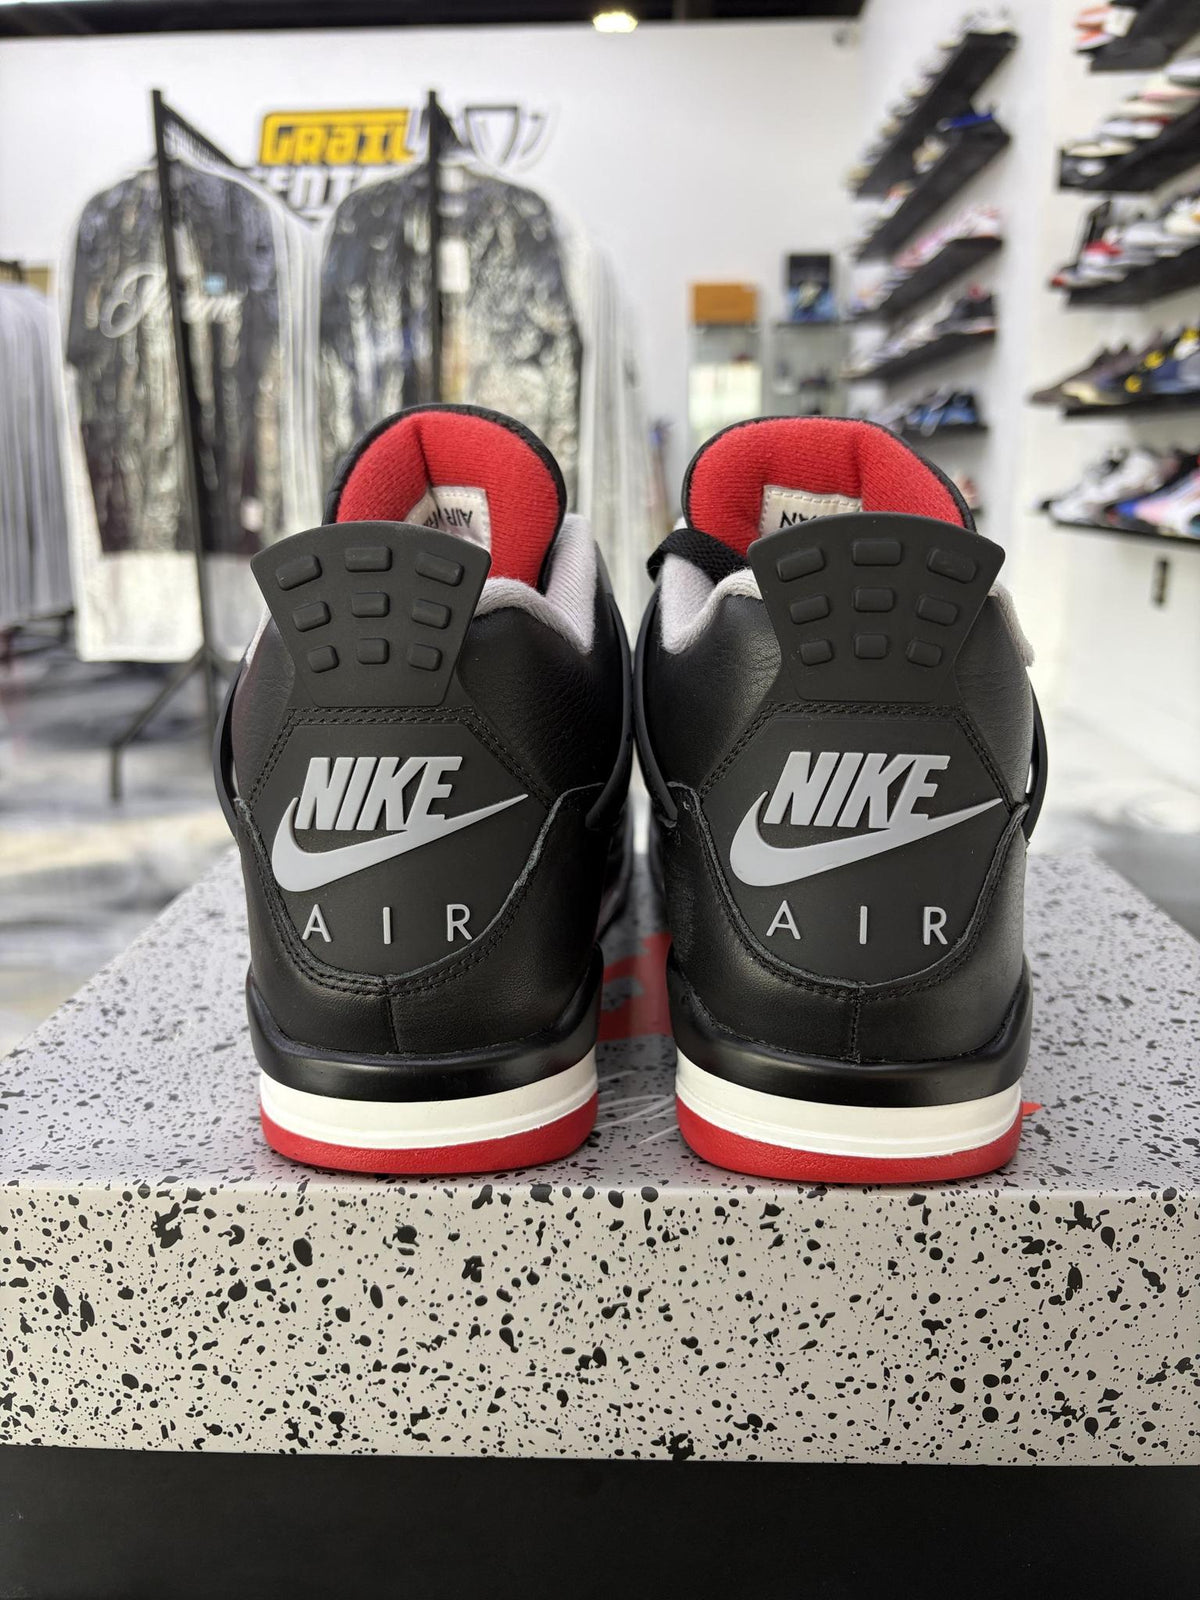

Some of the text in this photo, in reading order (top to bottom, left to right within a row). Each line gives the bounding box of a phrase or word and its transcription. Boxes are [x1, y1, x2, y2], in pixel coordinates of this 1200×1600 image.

[295, 756, 463, 831] NIKE
[763, 751, 951, 829] NIKE
[302, 904, 473, 945] AIR
[766, 900, 948, 945] AIR
